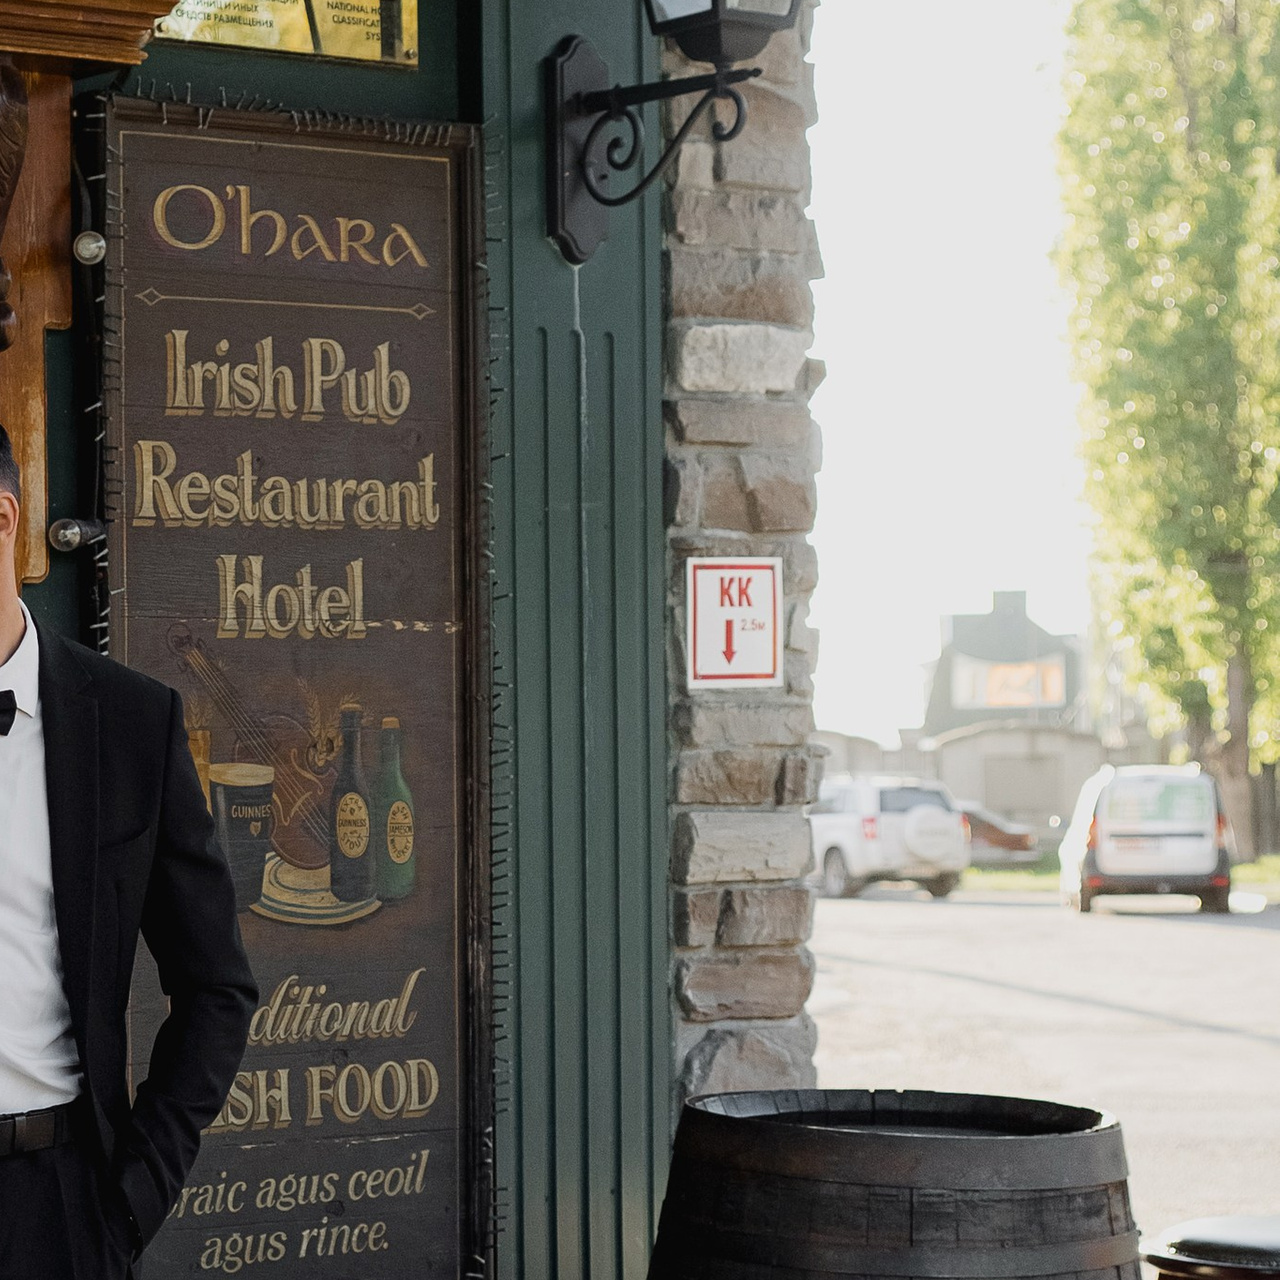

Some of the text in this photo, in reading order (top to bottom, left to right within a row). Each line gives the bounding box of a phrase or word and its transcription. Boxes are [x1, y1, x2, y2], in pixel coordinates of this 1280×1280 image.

[175, 5, 274, 29] СРЕДСТВ РАЗМЕЩЕНИЯ
[233, 1, 259, 13] ИНЫХ
[326, 0, 370, 15] NATIONAL
[165, 329, 411, 425] Irish Pub
[132, 439, 440, 531] Restaurant
[215, 553, 366, 640] Hotel
[340, 796, 363, 813] EXTRA
[390, 805, 410, 821] IRISH
[340, 831, 364, 851] STOUT
[247, 966, 427, 1047] ditional
[305, 1058, 439, 1126] FOOD
[254, 1170, 339, 1213] agus
[348, 1149, 431, 1199] ceoil
[200, 1217, 390, 1273] agus rince.
